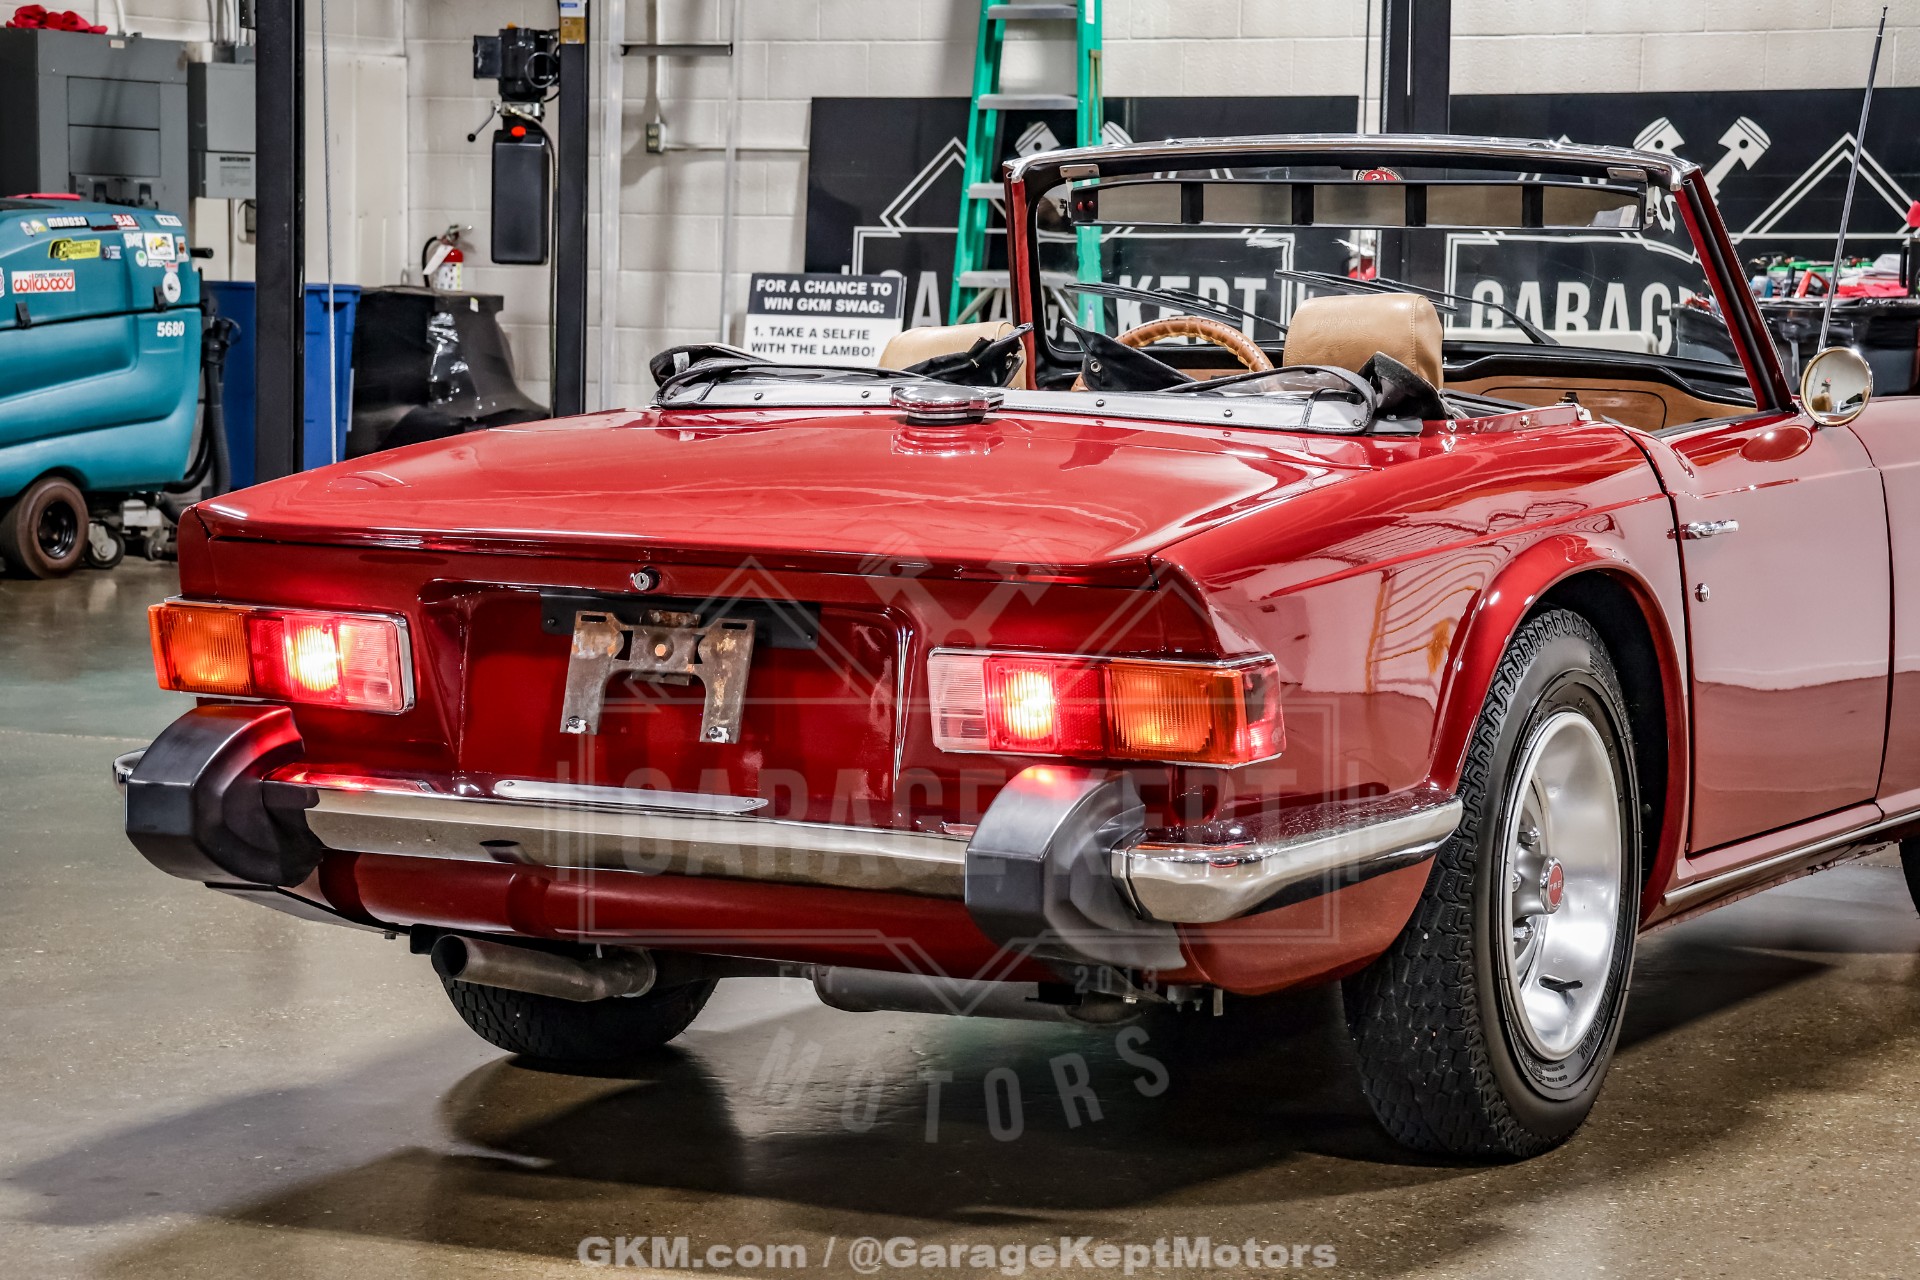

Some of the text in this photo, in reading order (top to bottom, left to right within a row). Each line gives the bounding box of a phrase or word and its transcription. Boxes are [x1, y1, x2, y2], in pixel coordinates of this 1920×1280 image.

[14, 272, 74, 292] wilwood
[757, 279, 892, 296] FOR A CHANCE TO
[764, 297, 885, 314] WIN GKM SWAG:
[1470, 280, 1694, 355] GARAG
[157, 321, 185, 337] 5680
[754, 326, 870, 340] 1. TAKE A SELFIE
[751, 342, 875, 357] WITH THE LAMBO!
